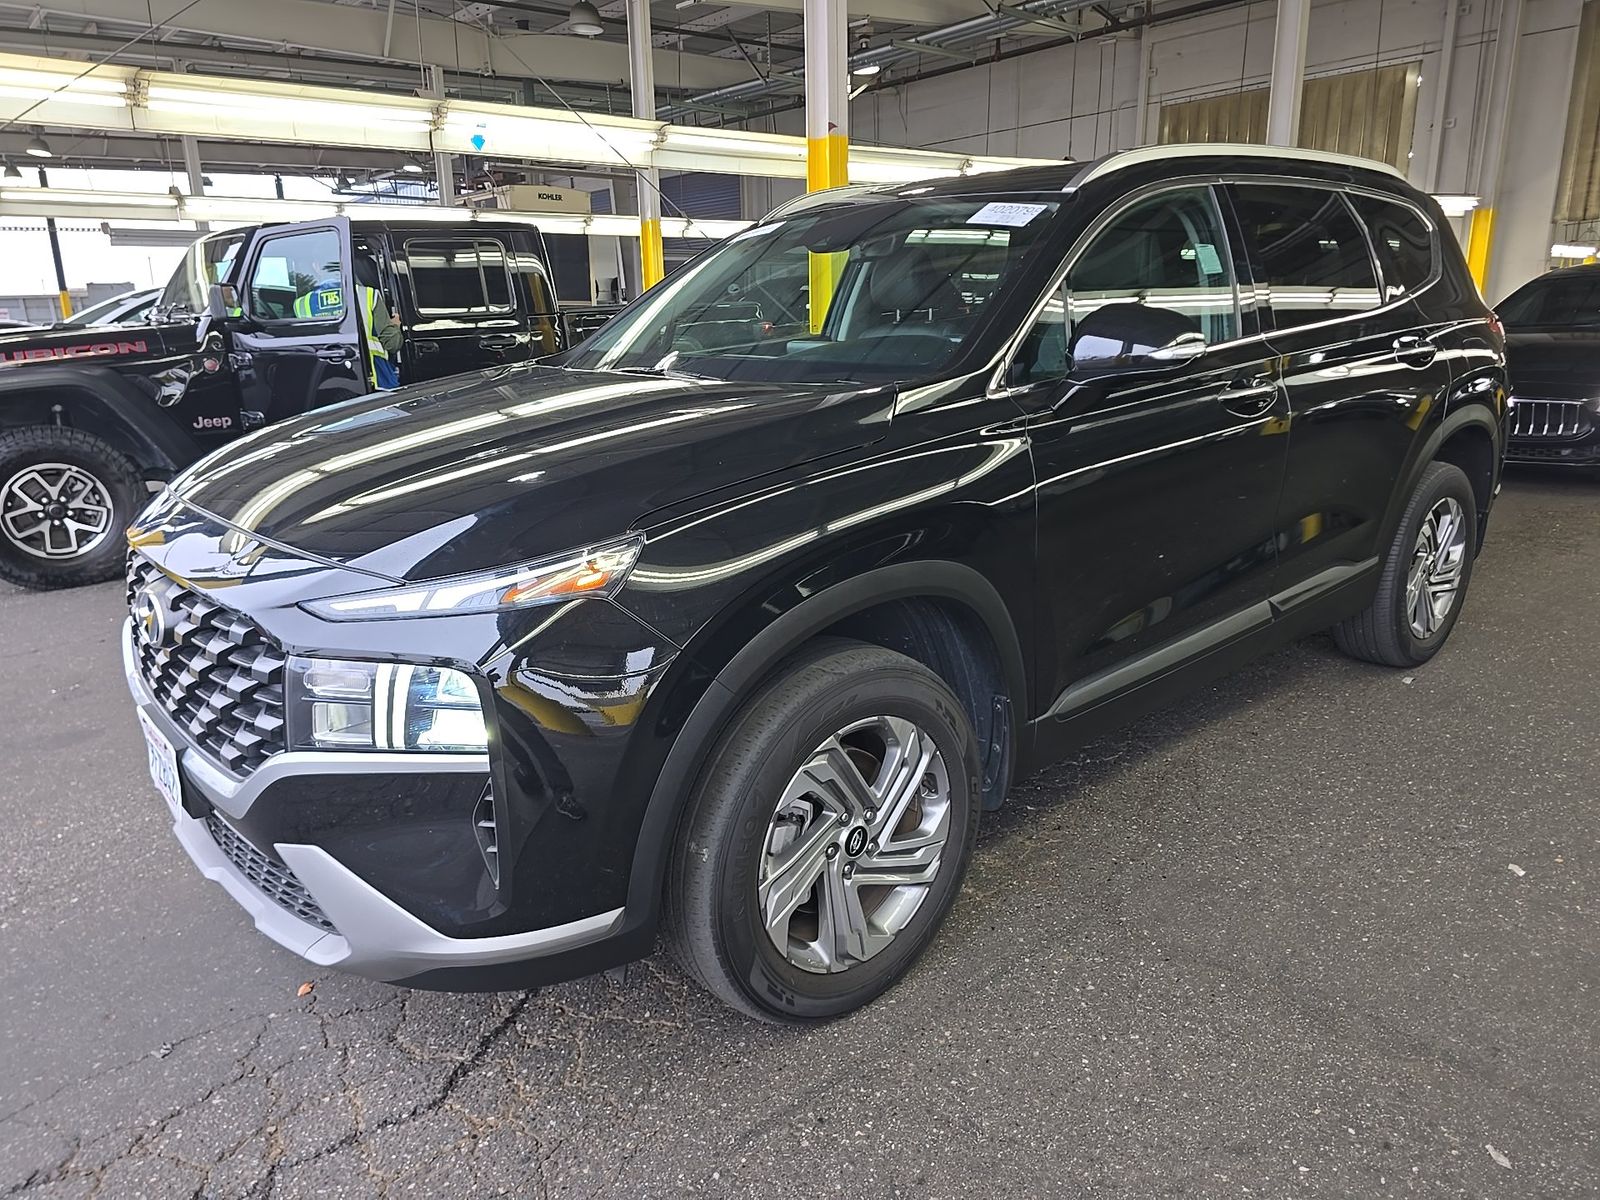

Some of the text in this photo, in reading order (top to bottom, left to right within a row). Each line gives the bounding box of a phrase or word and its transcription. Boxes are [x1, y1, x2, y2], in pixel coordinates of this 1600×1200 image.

[538, 192, 563, 201] KOHLER
[0, 340, 147, 364] UBICON
[193, 416, 232, 429] Jeep
